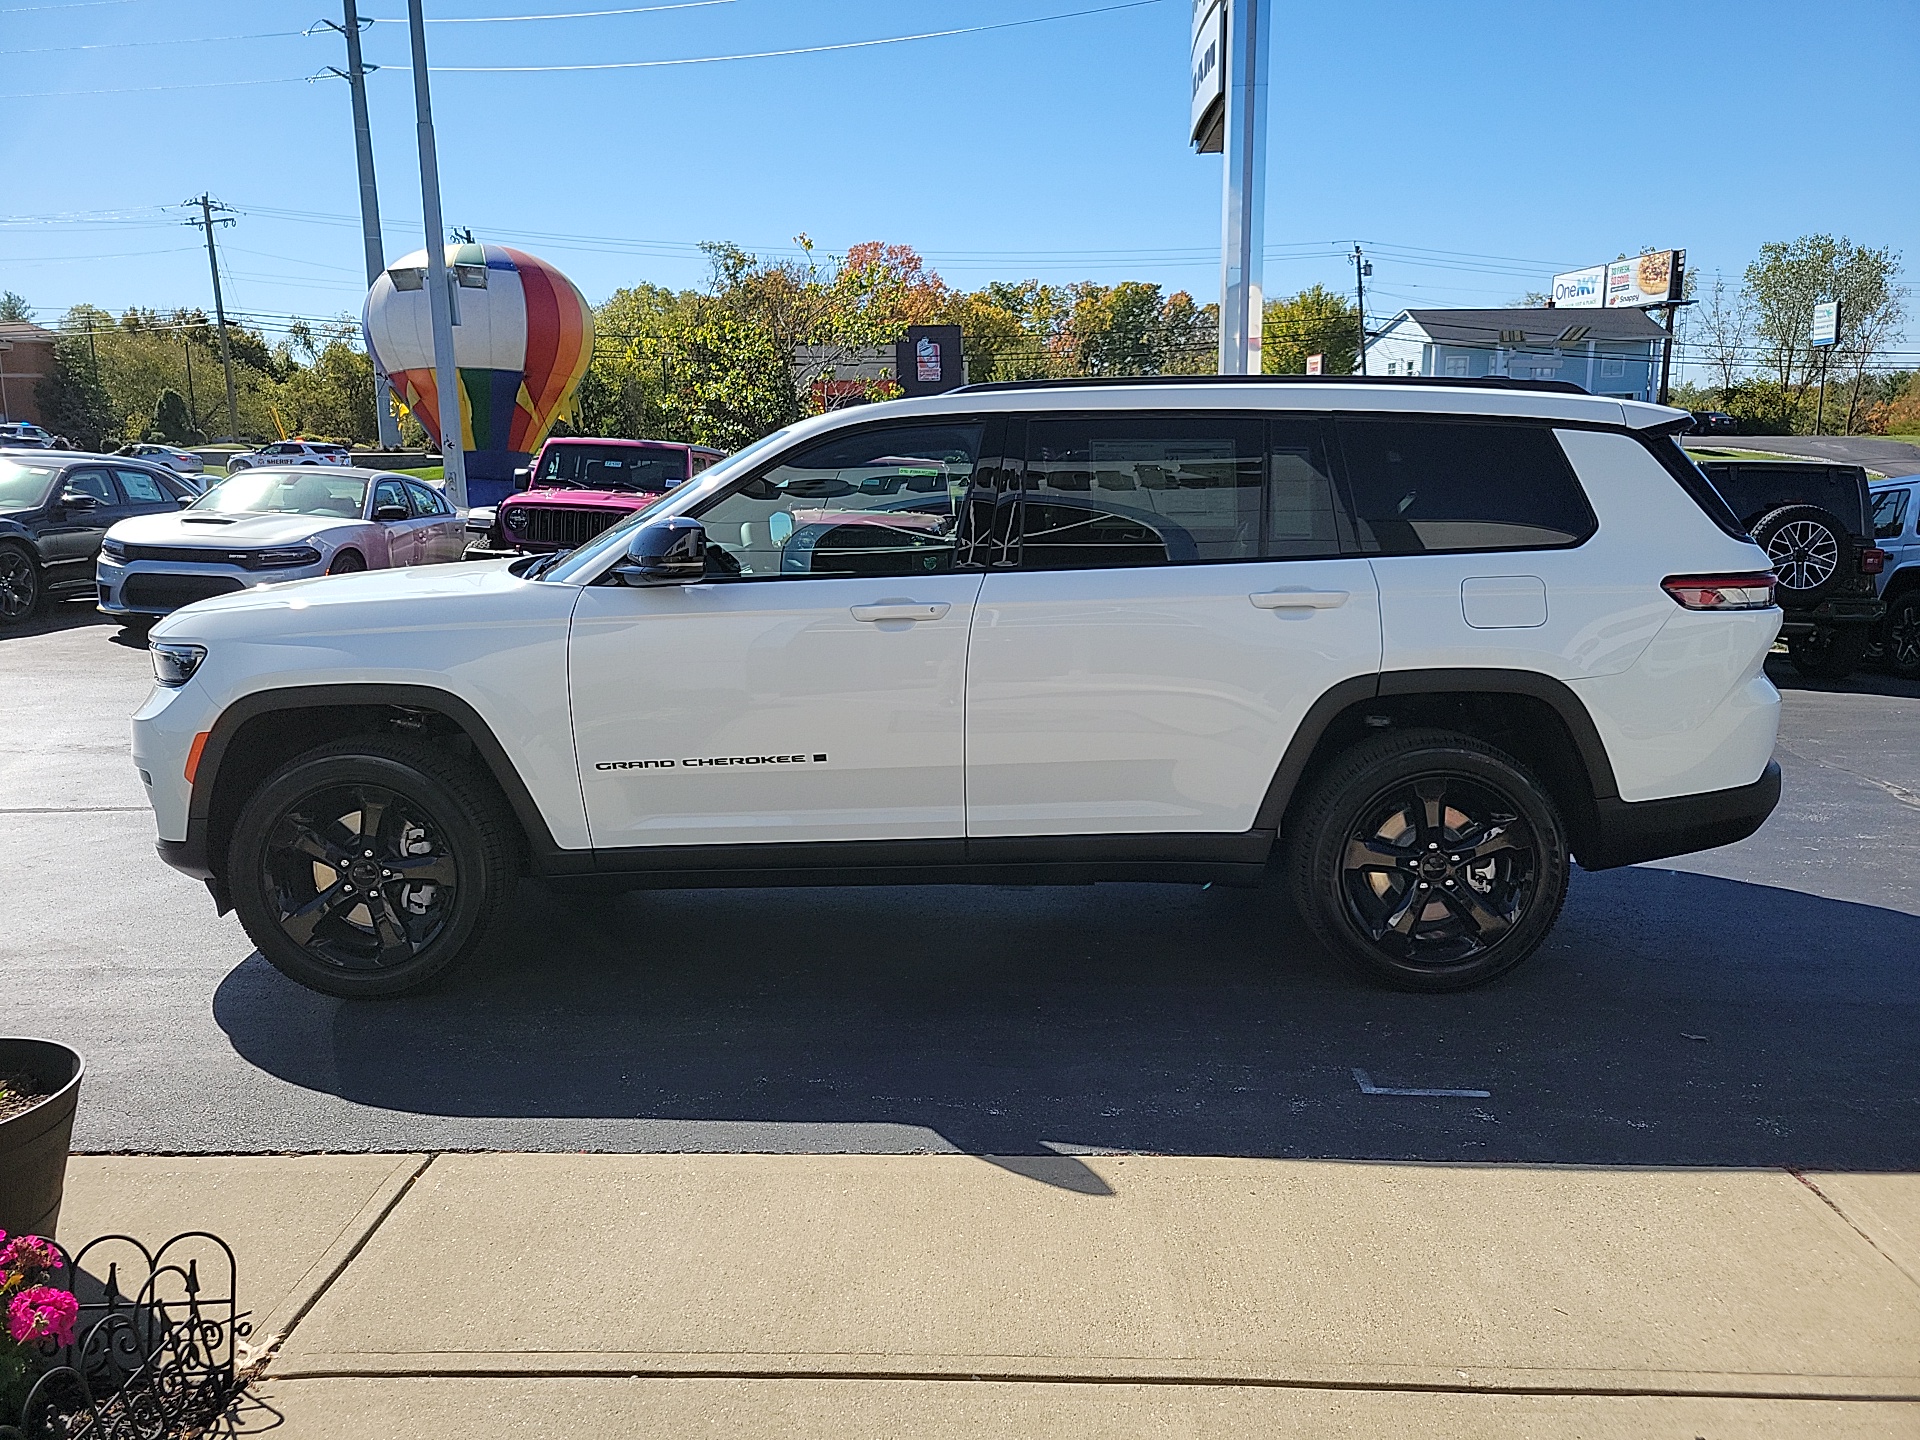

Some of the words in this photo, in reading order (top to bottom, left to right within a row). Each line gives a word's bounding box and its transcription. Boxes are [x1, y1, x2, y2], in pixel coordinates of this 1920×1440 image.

[1619, 294, 1640, 303] Snappy
[595, 759, 675, 771] GRAND
[682, 754, 806, 767] CHEROKEE
